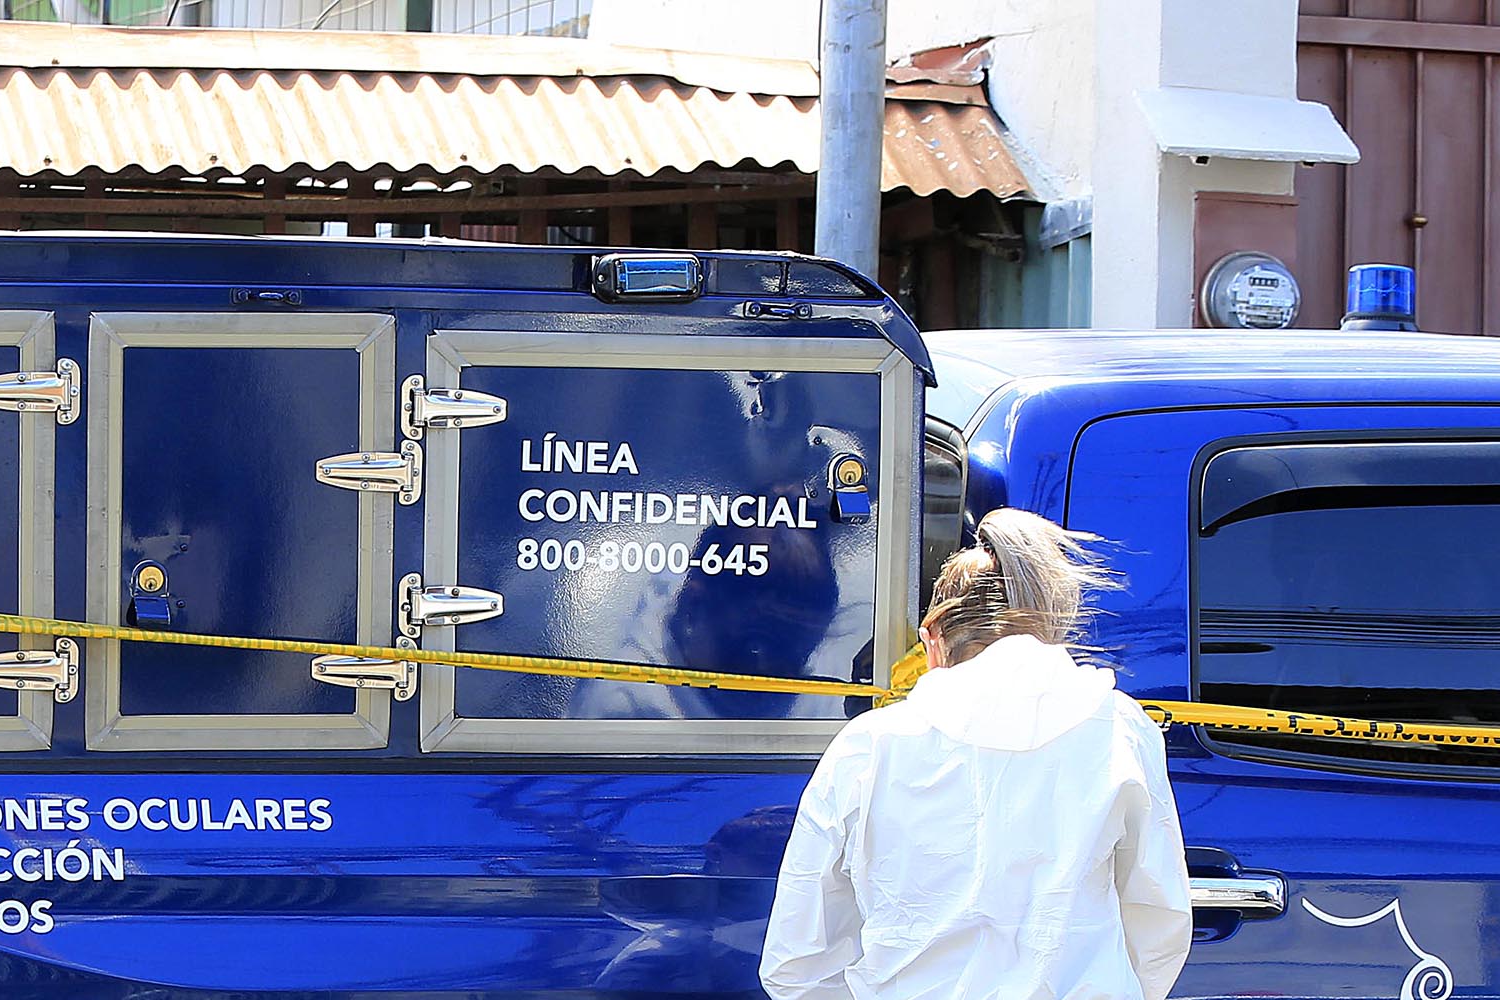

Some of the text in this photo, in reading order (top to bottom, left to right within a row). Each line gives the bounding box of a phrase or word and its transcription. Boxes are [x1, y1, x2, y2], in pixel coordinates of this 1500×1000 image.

[520, 432, 640, 476] LÍNEA
[518, 489, 818, 530] CONFIDENCIAL
[516, 537, 769, 577] 800-8000-645
[102, 797, 333, 832] OCULARES
